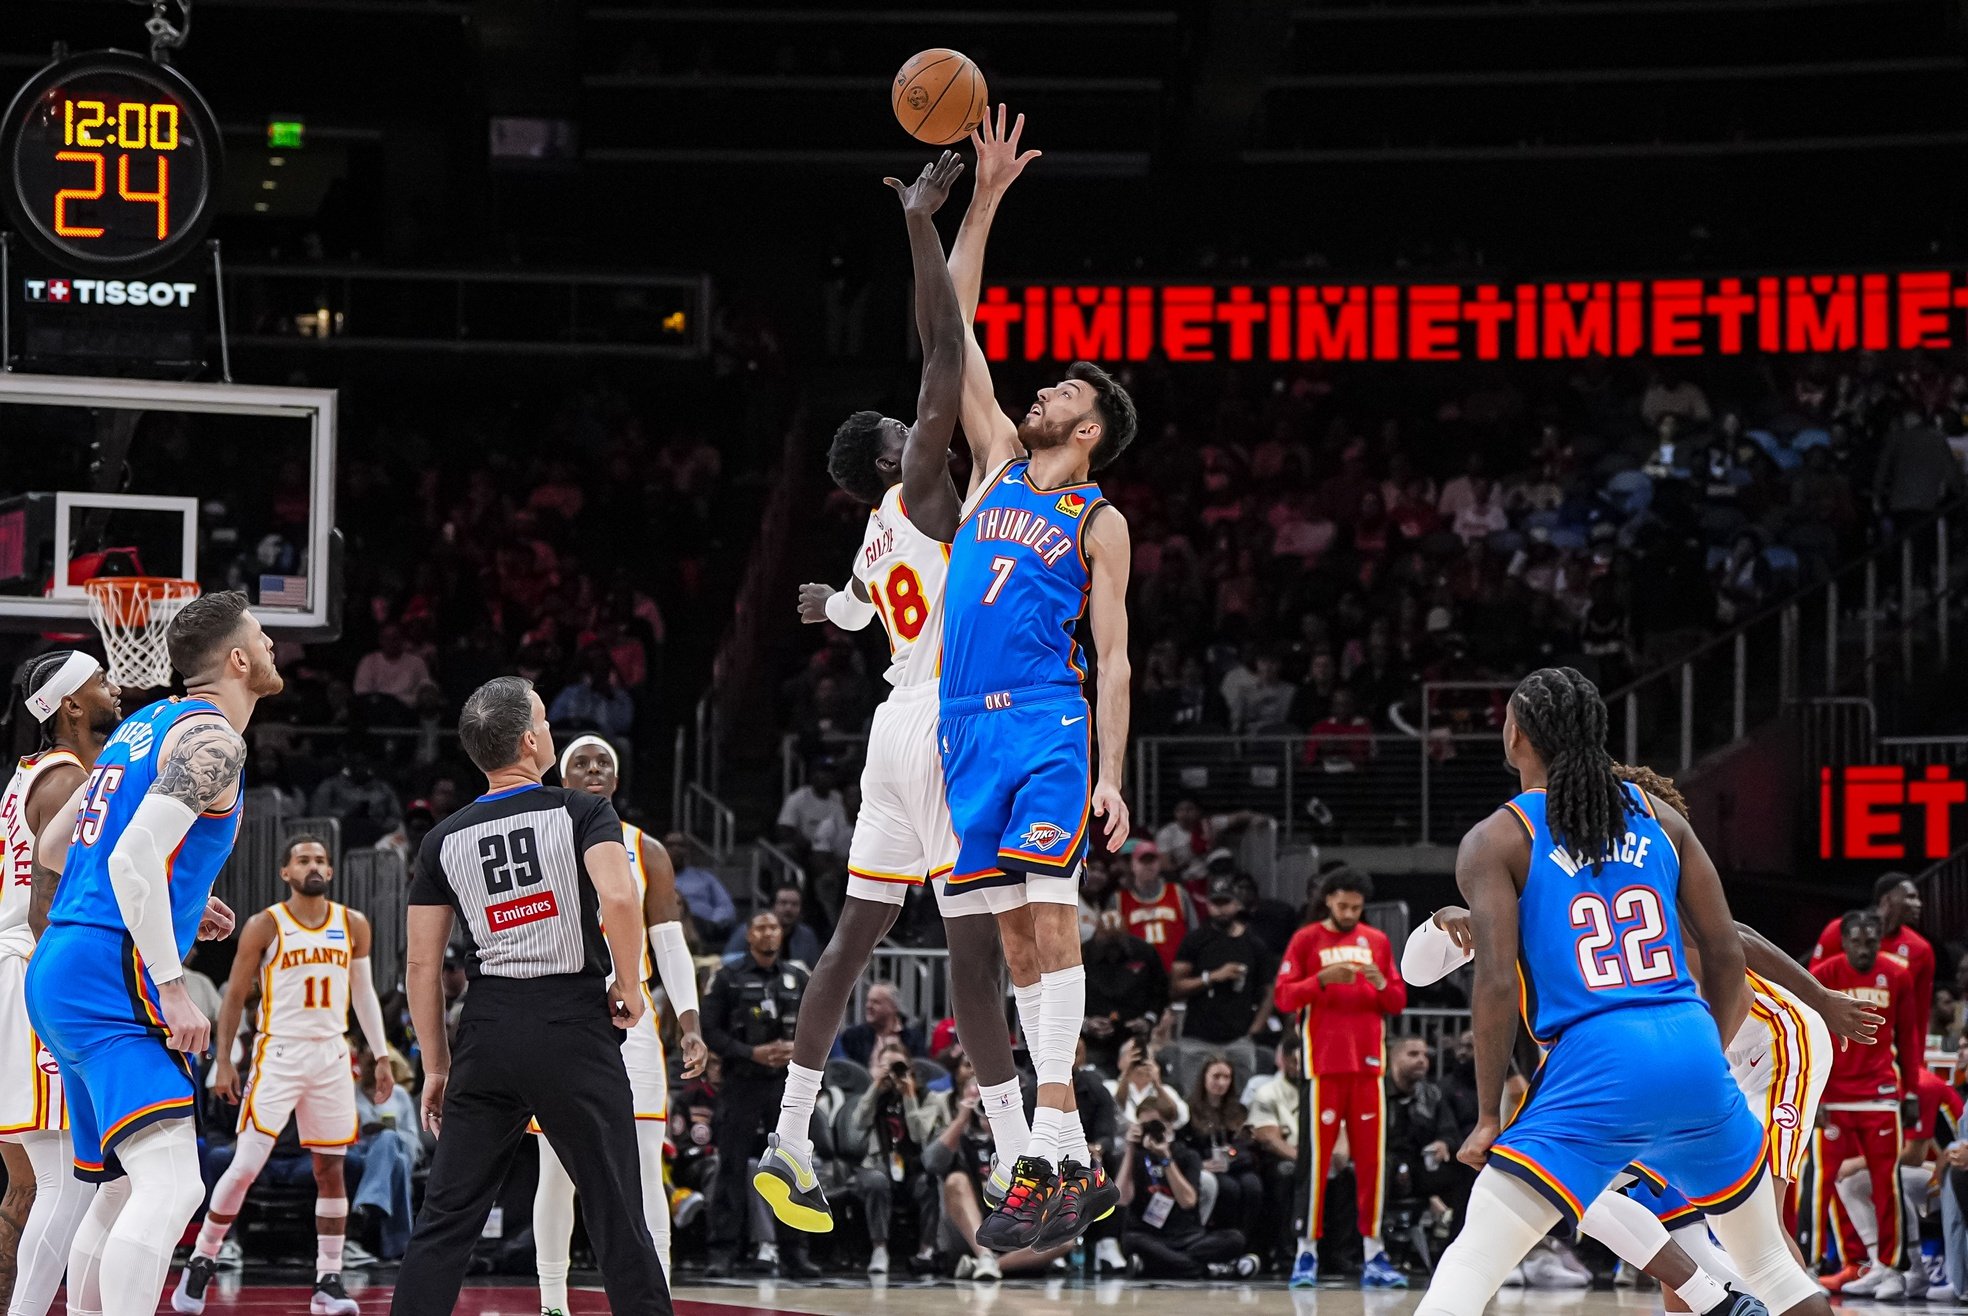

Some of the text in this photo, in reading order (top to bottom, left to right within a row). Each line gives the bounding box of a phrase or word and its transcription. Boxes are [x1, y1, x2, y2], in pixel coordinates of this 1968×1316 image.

[65, 100, 178, 150] 12:00
[55, 151, 168, 240] 24
[72, 279, 197, 307] TISSOT
[1057, 503, 1079, 517] Love's
[975, 507, 1076, 568] THUNDER
[980, 555, 1017, 605] 7
[869, 561, 930, 655] 18
[985, 691, 1012, 711] OKC
[70, 765, 125, 848] 55
[1029, 829, 1055, 842] OKC
[478, 827, 544, 896] 29
[493, 900, 551, 925] Emirates
[281, 947, 348, 971] ATLANTA
[1569, 885, 1677, 992] 22
[304, 976, 331, 1008] 11
